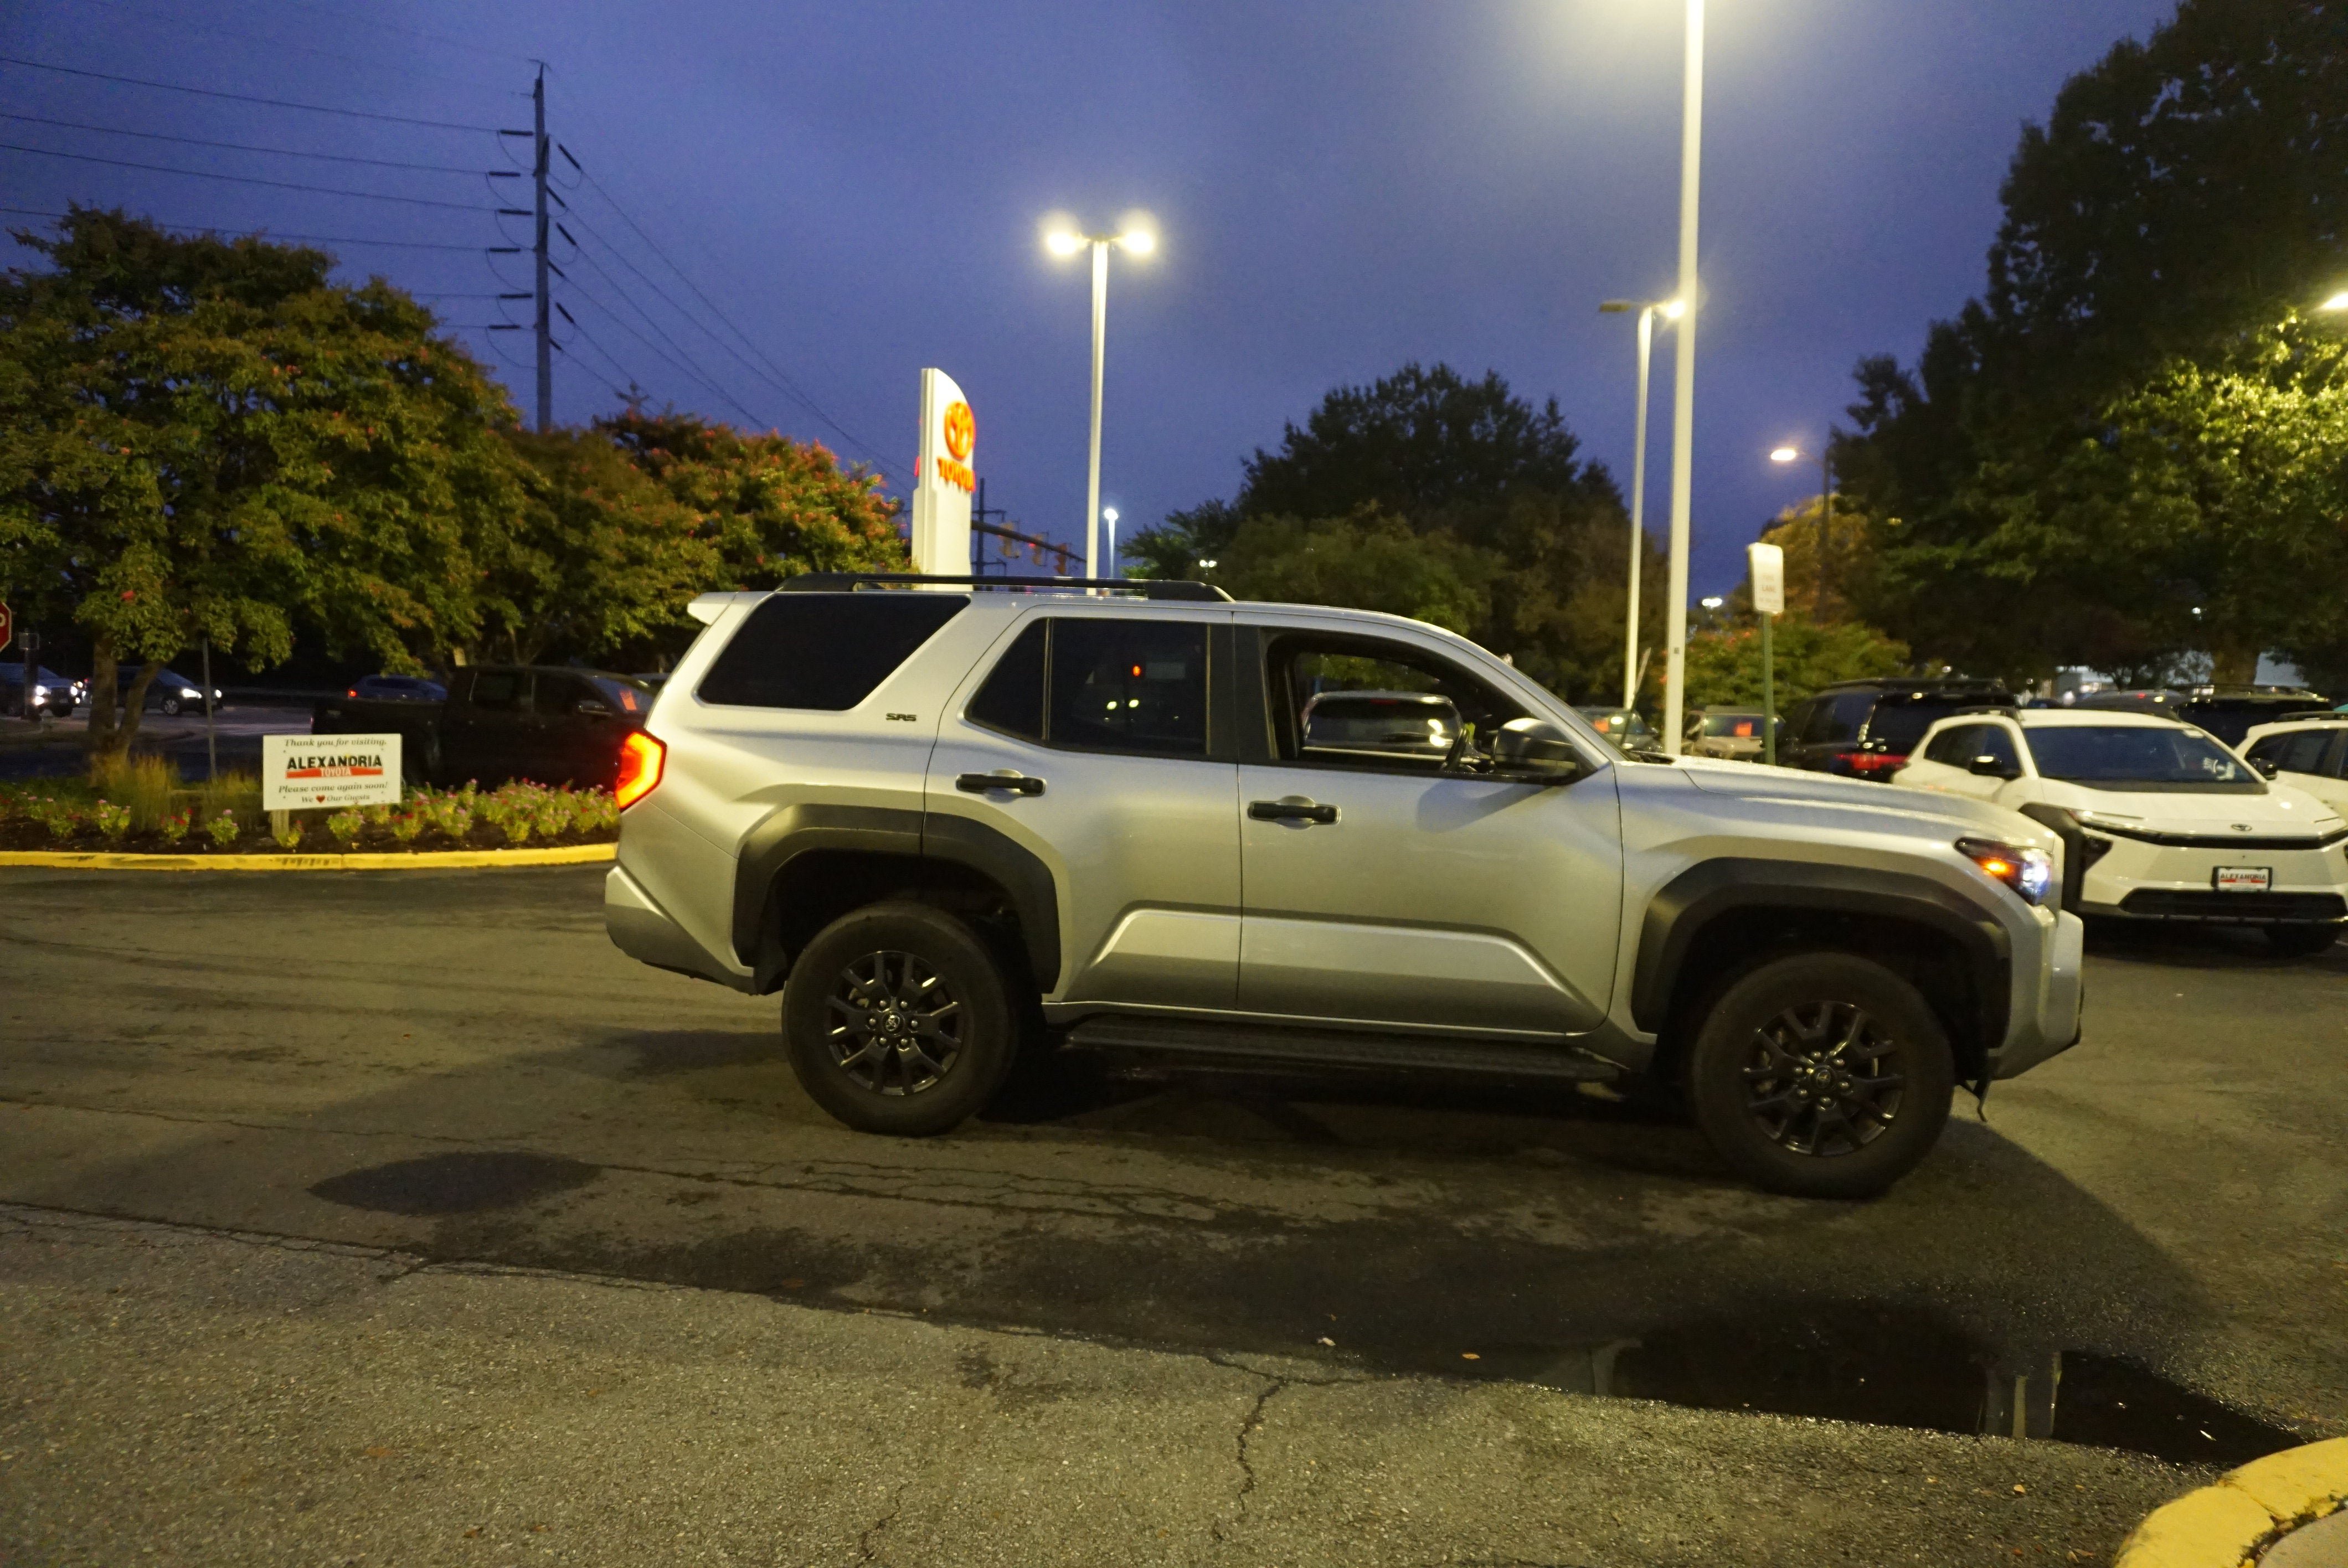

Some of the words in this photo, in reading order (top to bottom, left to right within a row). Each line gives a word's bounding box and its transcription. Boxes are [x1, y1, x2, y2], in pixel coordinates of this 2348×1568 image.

[334, 738, 349, 747] for
[287, 754, 383, 770] ALEXANDRIA
[320, 767, 351, 777] TOYOTA
[337, 782, 362, 791] again
